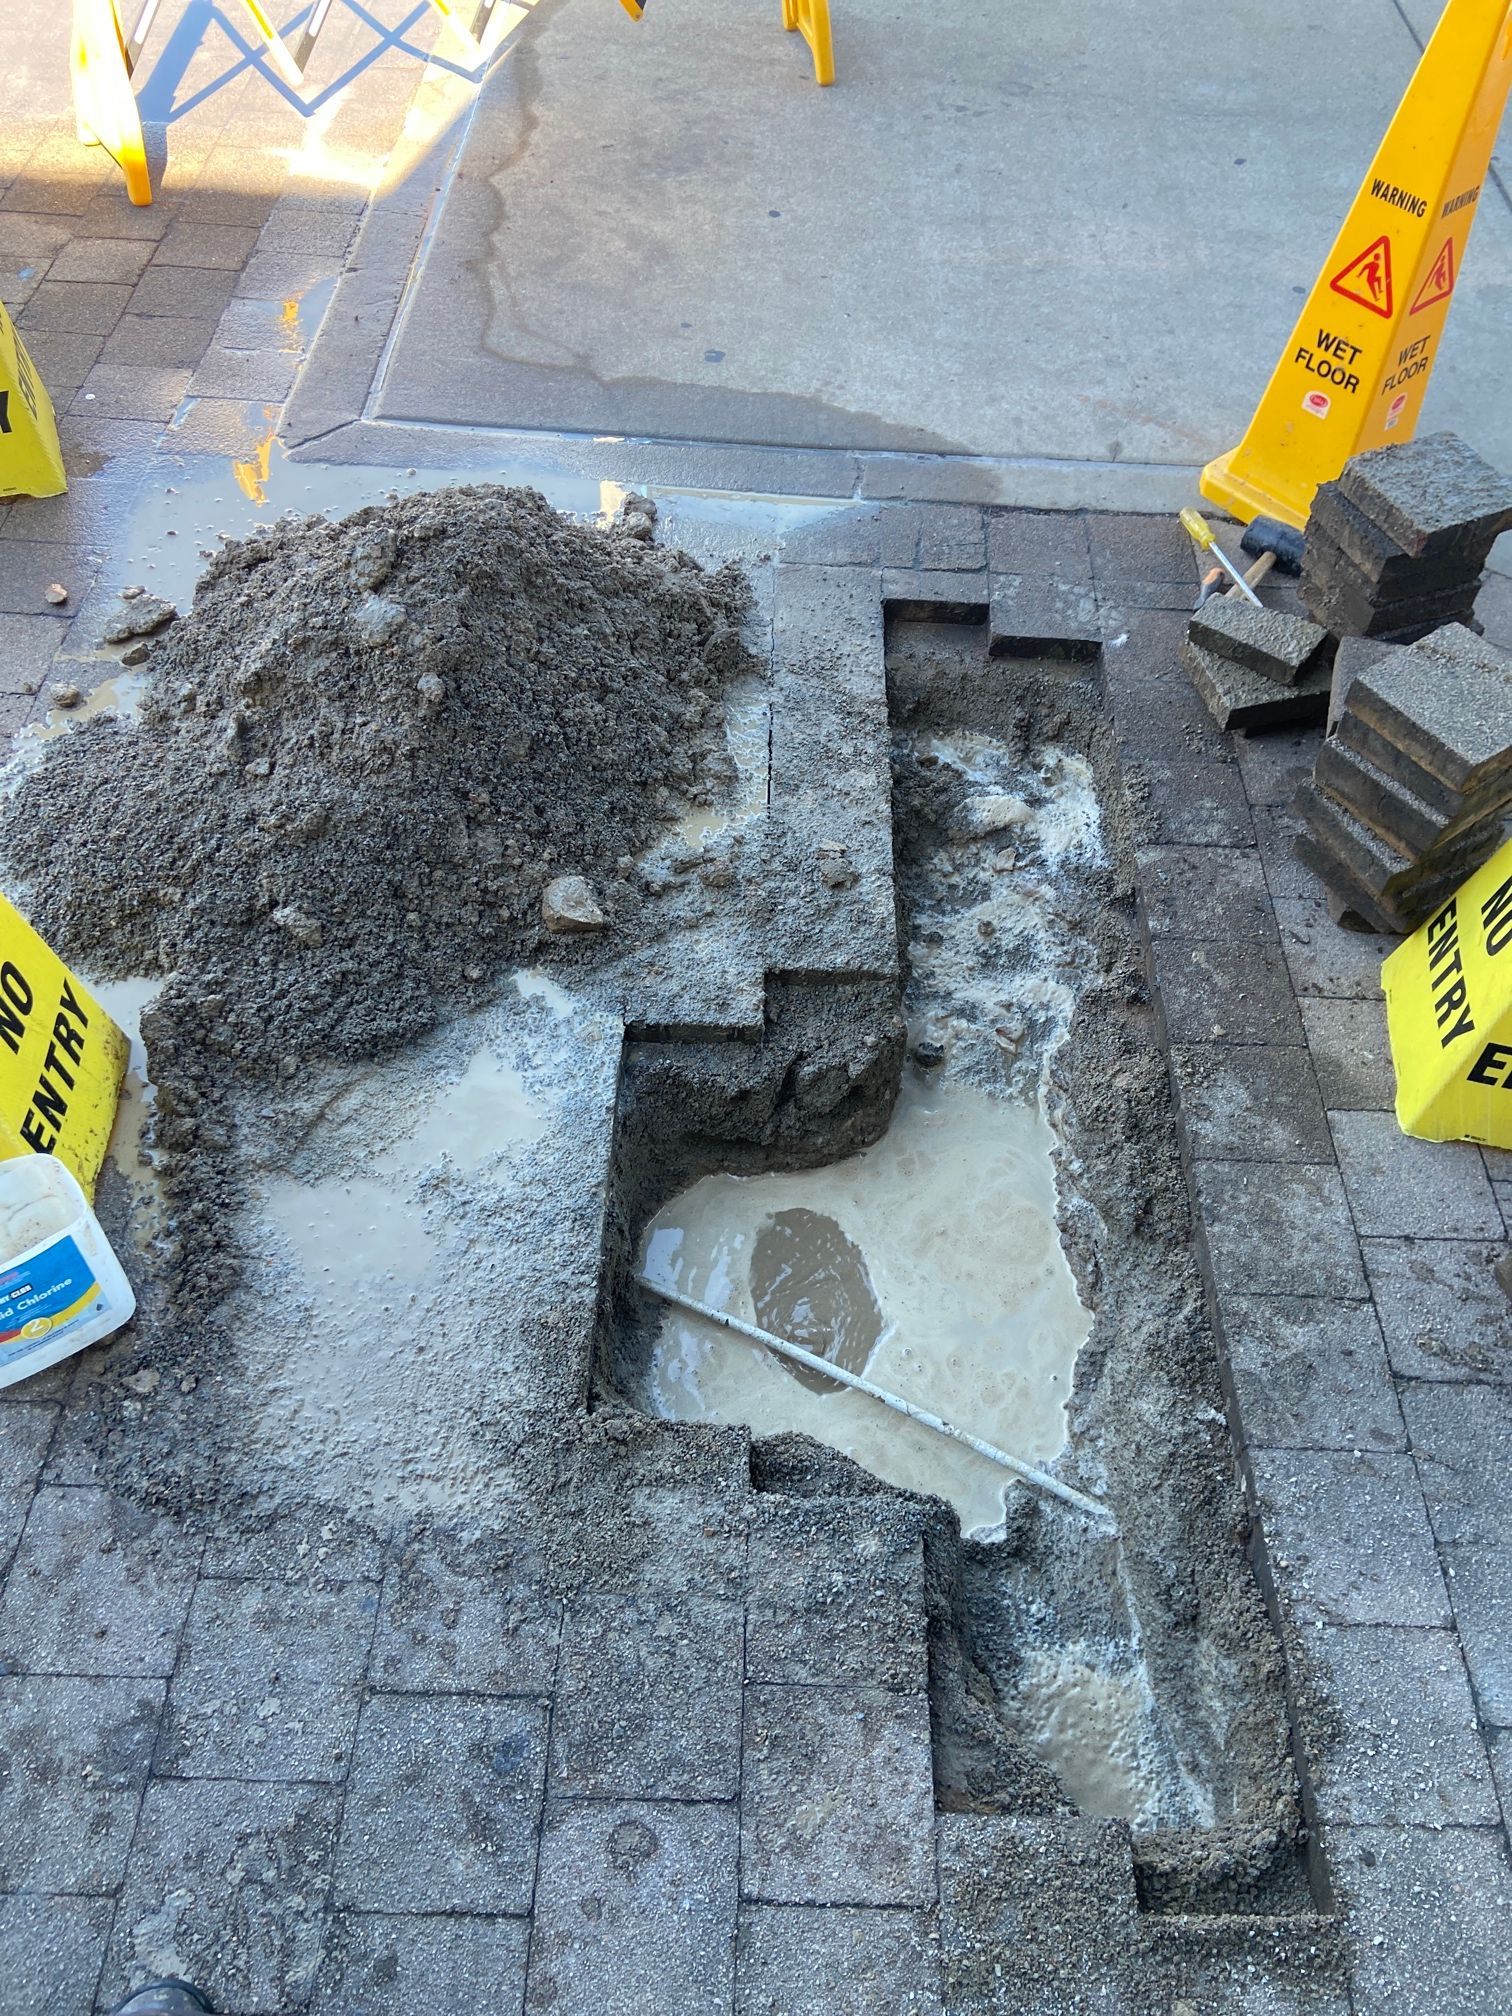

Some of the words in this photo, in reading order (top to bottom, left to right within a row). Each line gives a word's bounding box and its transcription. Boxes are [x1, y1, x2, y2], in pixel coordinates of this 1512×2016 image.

[1371, 178, 1427, 217] WARNING
[1441, 185, 1480, 218] WARNING
[1317, 328, 1362, 365] WET
[1398, 335, 1431, 366] WET
[1295, 347, 1360, 394] FLOOR
[1382, 356, 1428, 396] FLOOR
[1427, 897, 1475, 1049] ENTRY
[0, 961, 33, 1055] NO
[20, 977, 88, 1155] ENTRY
[16, 1278, 72, 1310] Chlorine
